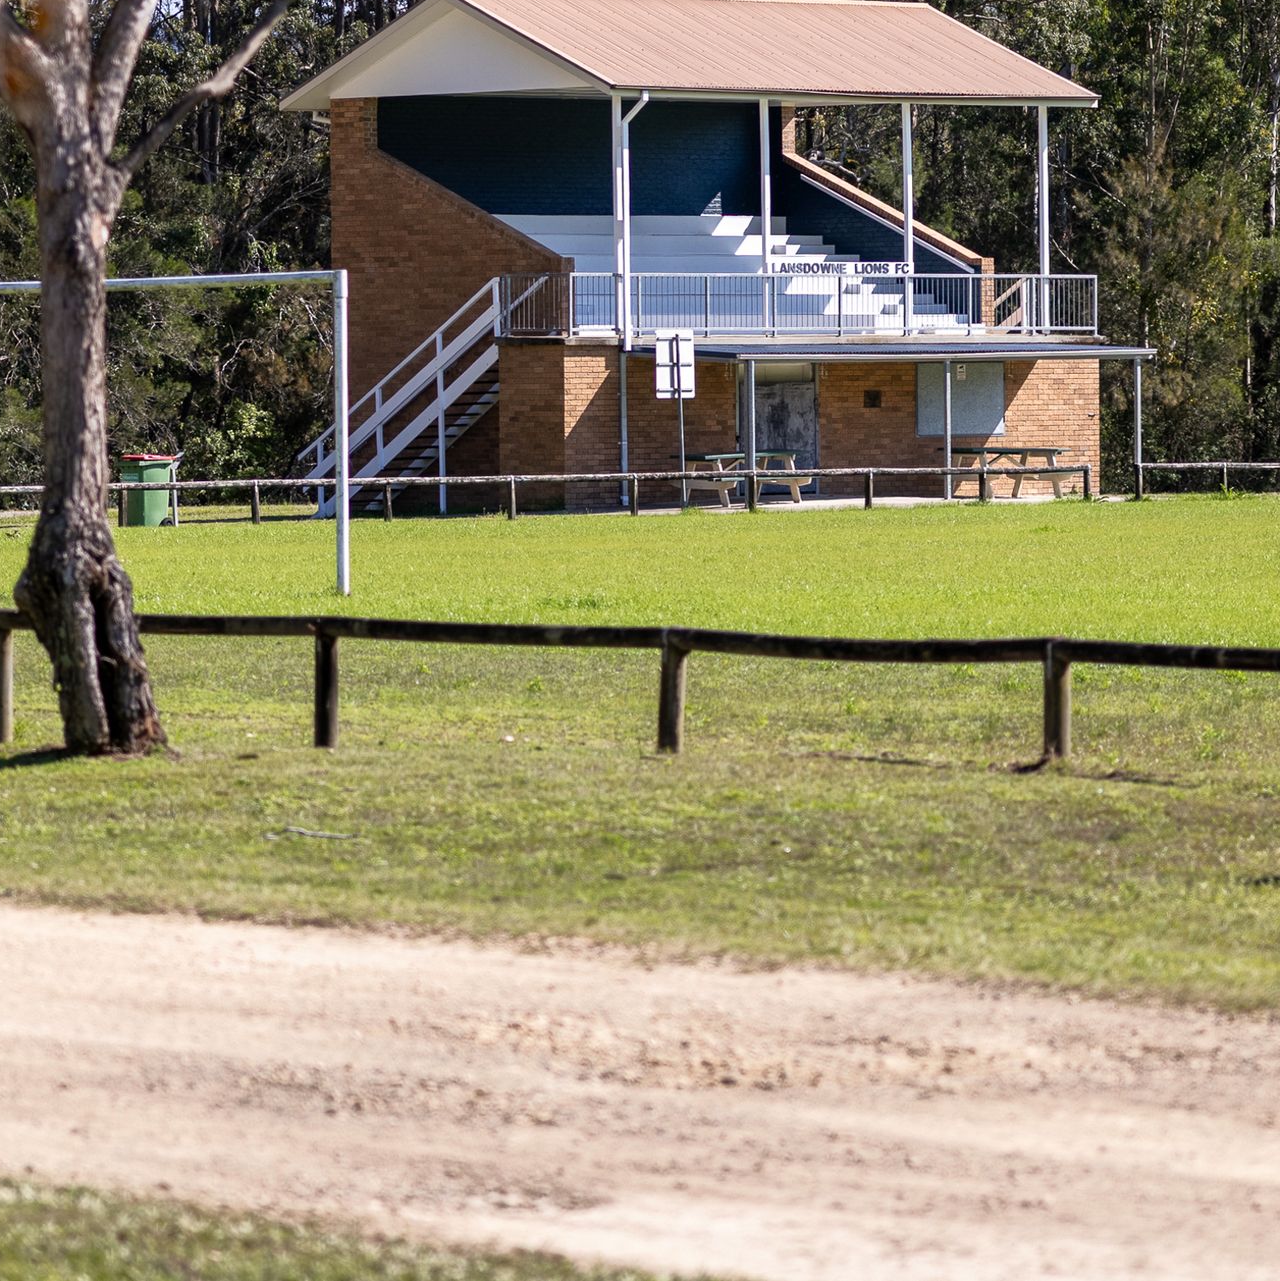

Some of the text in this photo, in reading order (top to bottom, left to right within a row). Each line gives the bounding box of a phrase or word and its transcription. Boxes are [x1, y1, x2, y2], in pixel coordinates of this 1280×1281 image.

[771, 263, 910, 274] LANSDOWNE LIONS FC
